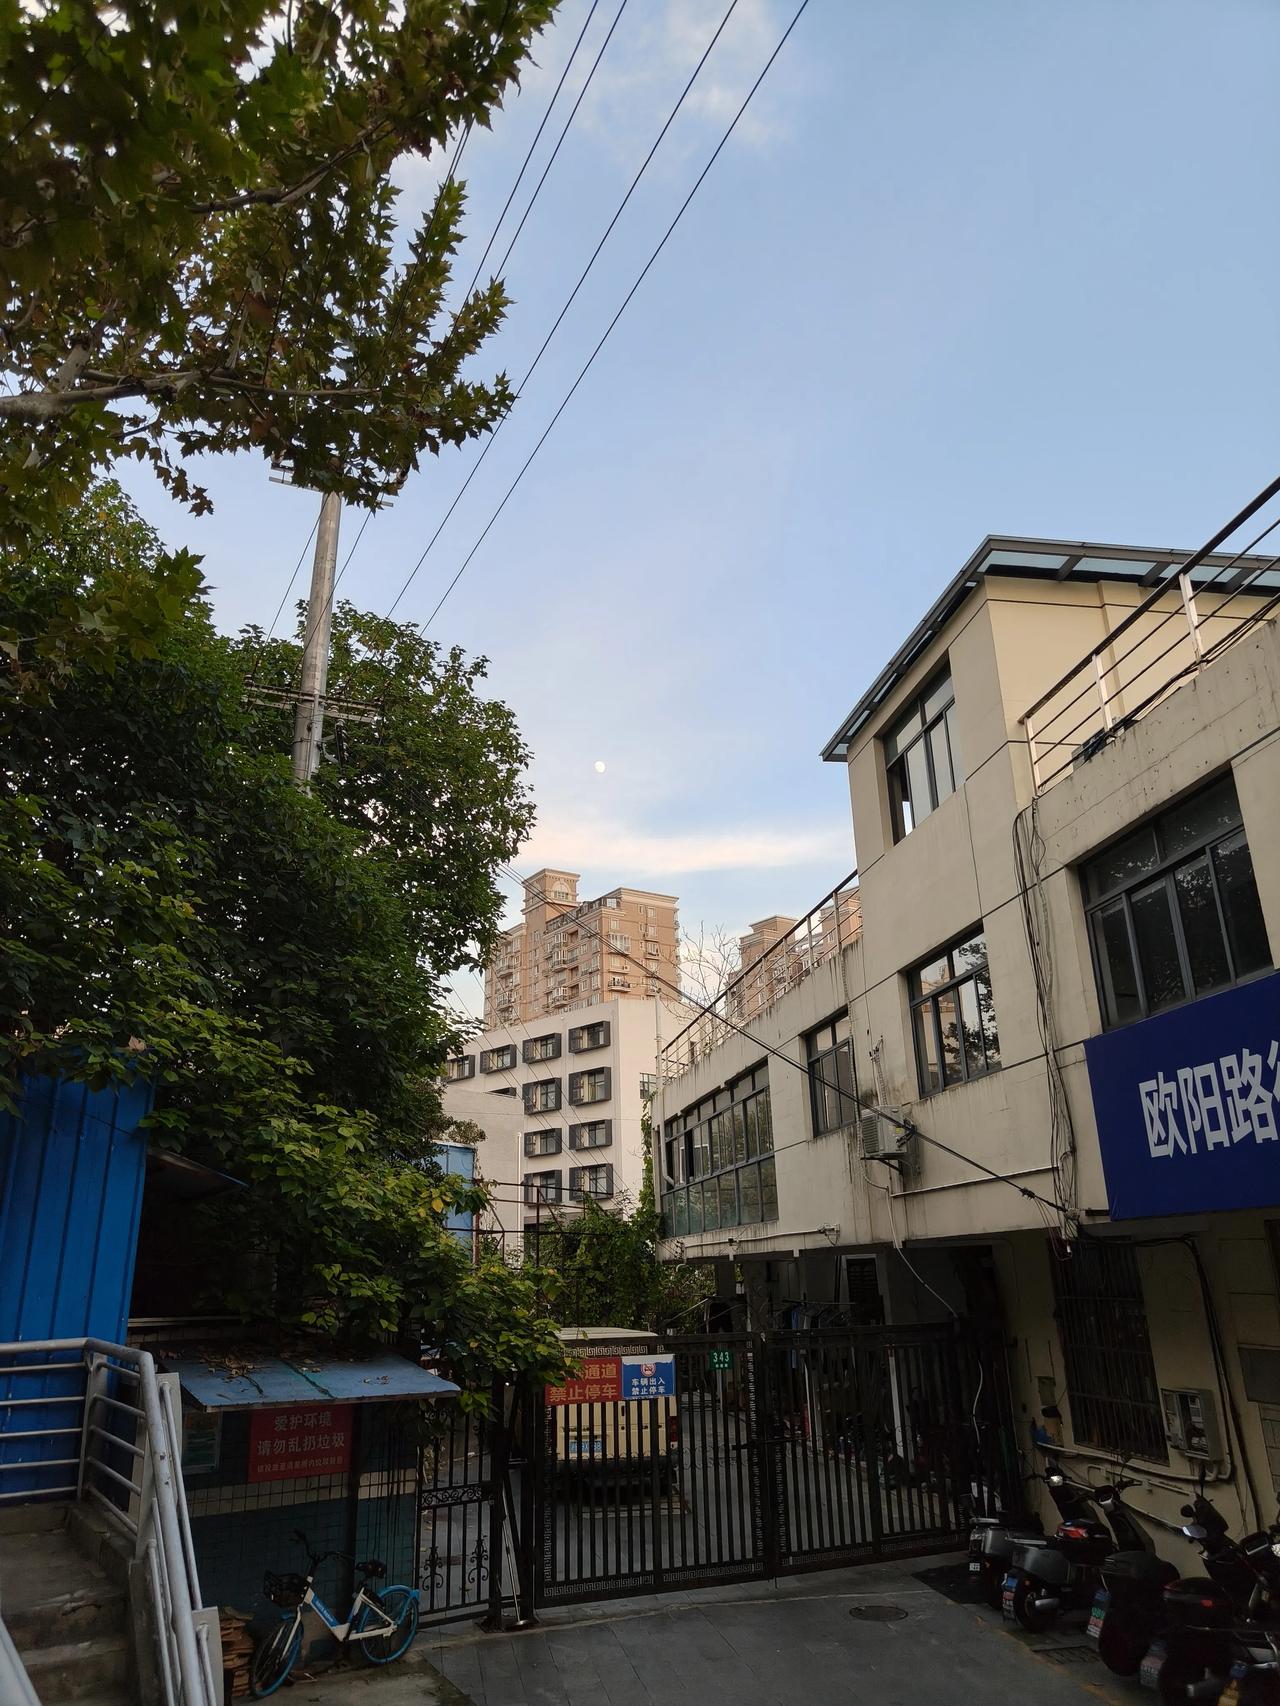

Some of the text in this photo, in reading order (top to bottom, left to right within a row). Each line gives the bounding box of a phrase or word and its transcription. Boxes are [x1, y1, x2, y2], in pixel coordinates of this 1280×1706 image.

[1138, 1040, 1280, 1158] 欧阳路
[713, 1351, 729, 1362] 343
[631, 1376, 666, 1386] 车辆出入
[549, 1383, 618, 1402] 禁止停车
[631, 1386, 666, 1396] 禁止停车
[273, 1411, 333, 1432] 爱护环境
[257, 1432, 345, 1457] 请勿乱扔垃圾
